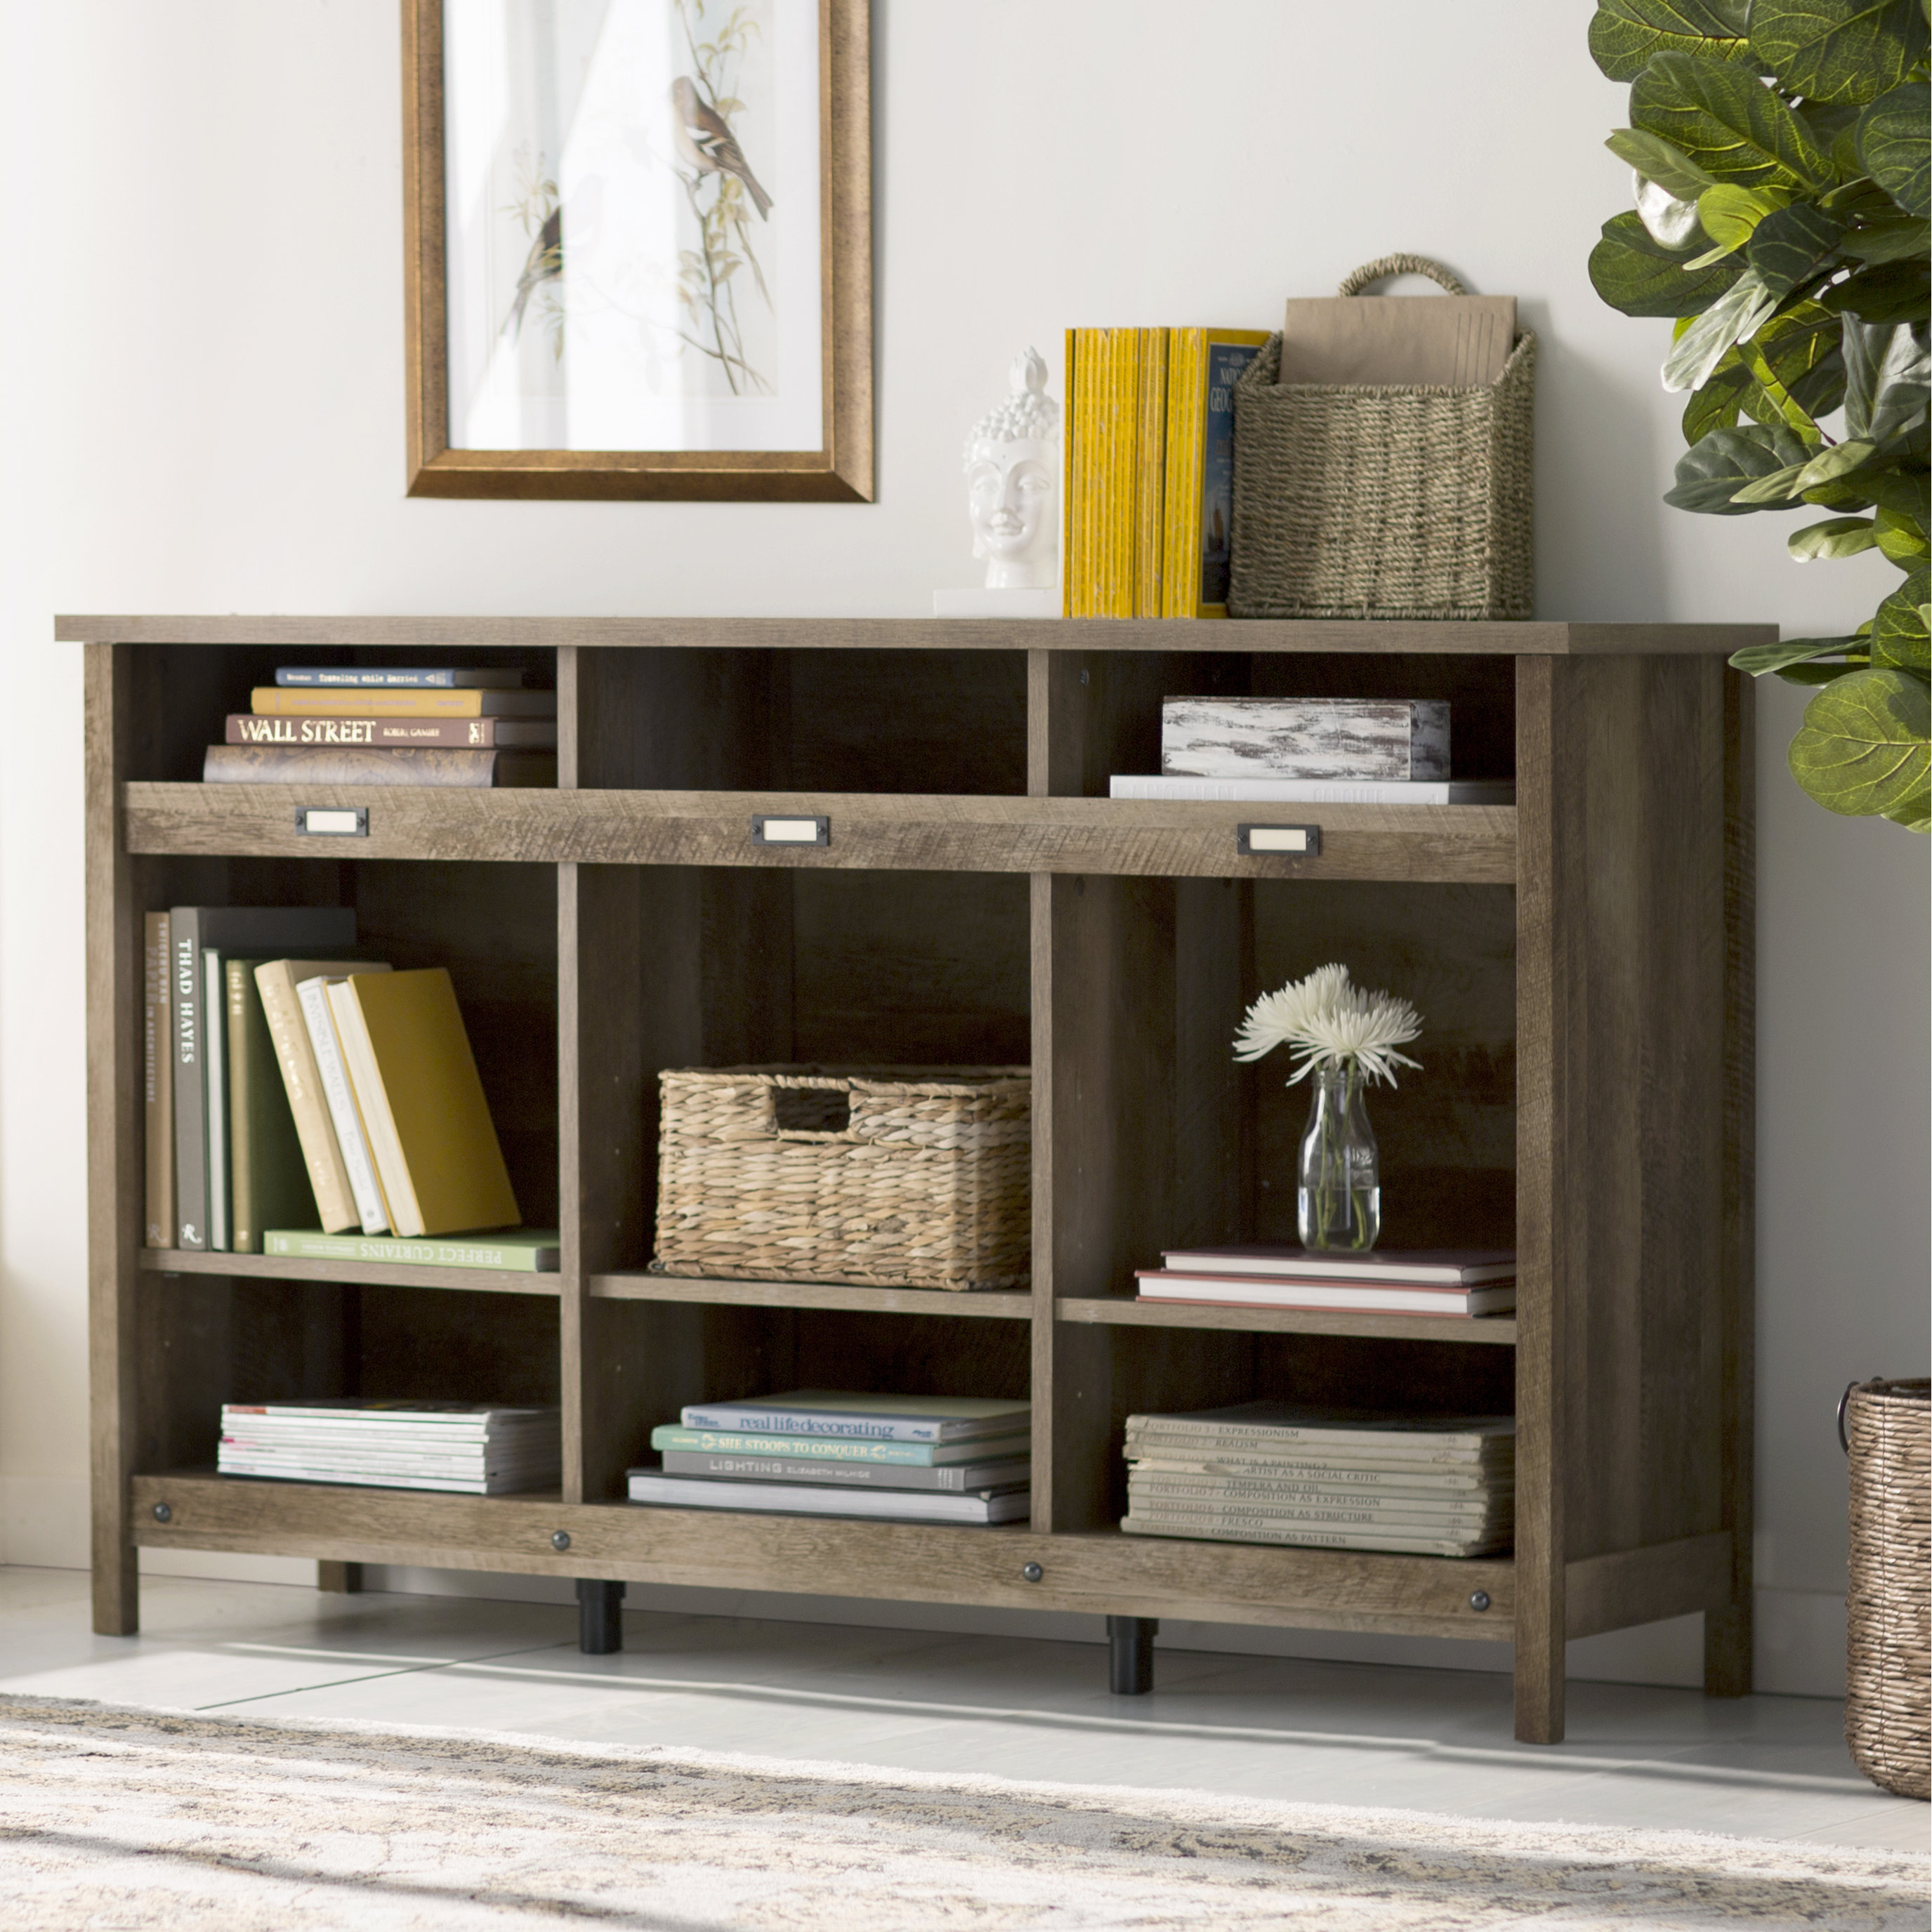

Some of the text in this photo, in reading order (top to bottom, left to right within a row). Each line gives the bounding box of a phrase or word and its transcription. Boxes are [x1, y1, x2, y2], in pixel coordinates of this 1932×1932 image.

[237, 720, 296, 742] WALL
[301, 720, 376, 742] STREET
[178, 939, 195, 1065] THAD HAYES
[360, 1242, 434, 1260] CURTAINS
[437, 1247, 503, 1265] PERFECT
[740, 1416, 770, 1430] real
[802, 1418, 895, 1438] decorating
[1218, 1426, 1299, 1438] EXPRESSIONISM
[718, 1438, 868, 1459] SHE STOOPS TO CONQUER
[1216, 1440, 1259, 1449] REALISM
[709, 1459, 782, 1473] LIGHTING
[1217, 1456, 1246, 1464] WHAT
[1282, 1469, 1294, 1478] AS
[1307, 1471, 1344, 1481] SOCIAL
[1347, 1472, 1381, 1483] CRITIC
[1226, 1480, 1274, 1490] TEMPERA
[1277, 1482, 1299, 1491] AND
[1303, 1483, 1321, 1492] OIL
[1223, 1489, 1296, 1501] COMPOSITION
[1299, 1494, 1312, 1503] AS
[1316, 1494, 1381, 1507] EXPRESSION
[1223, 1506, 1294, 1518] COMPOSITION
[1298, 1509, 1310, 1518] AS
[1315, 1511, 1374, 1522] STRUCTURE
[1221, 1518, 1263, 1528] FRESCO
[1211, 1527, 1282, 1540] COMPOSITION
[1285, 1532, 1298, 1541] AS
[1301, 1533, 1346, 1544] PATTERN
